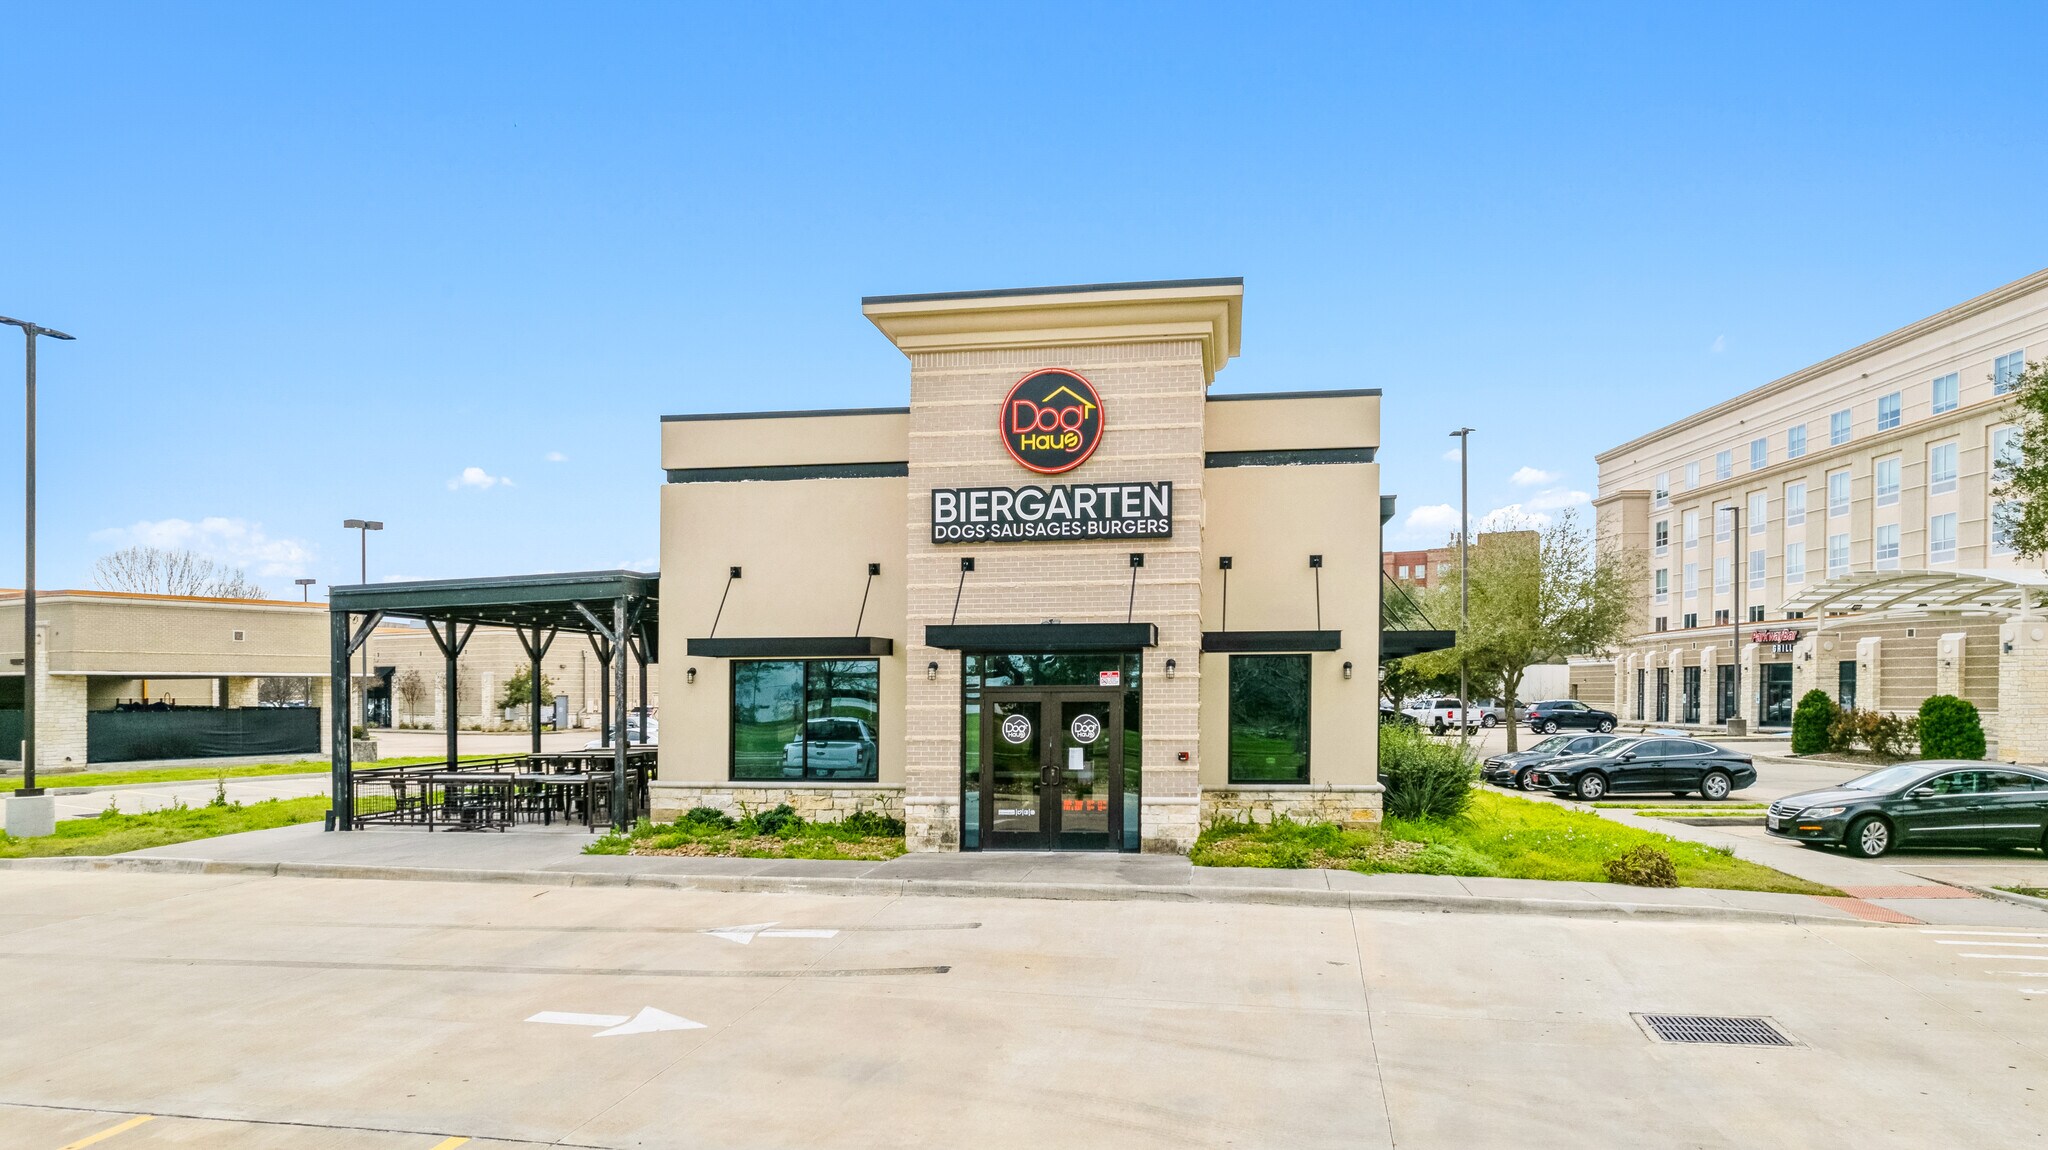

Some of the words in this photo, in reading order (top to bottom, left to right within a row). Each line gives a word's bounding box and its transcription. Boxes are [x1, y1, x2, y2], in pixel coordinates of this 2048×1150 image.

[1012, 400, 1084, 452] Dog
[1021, 433, 1078, 450] Haus
[935, 485, 1168, 523] BIERGARTEN
[1772, 643, 1793, 652] GRILL
[1005, 722, 1027, 738] Dog
[1074, 722, 1096, 738] Dog
